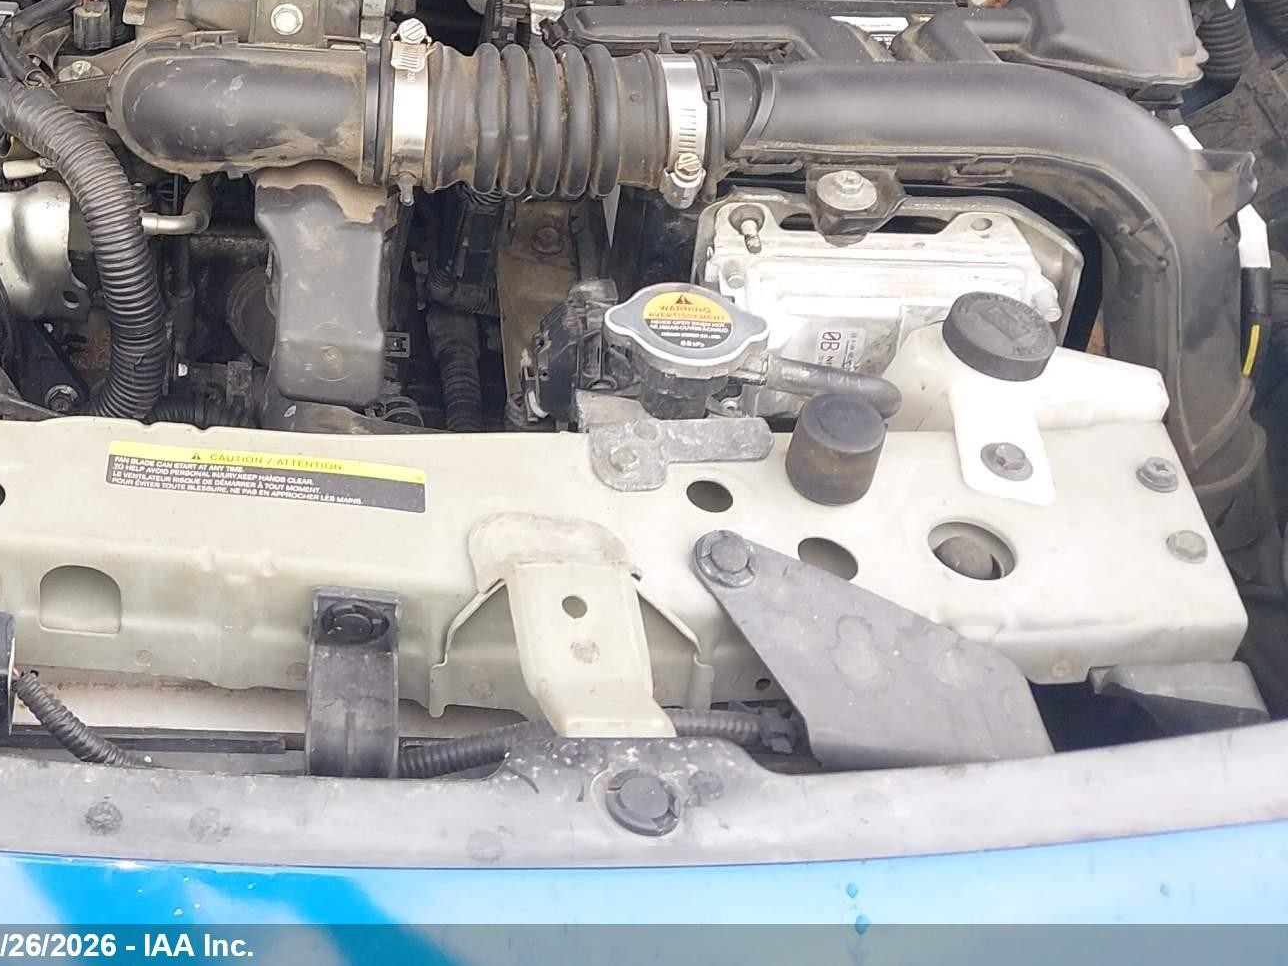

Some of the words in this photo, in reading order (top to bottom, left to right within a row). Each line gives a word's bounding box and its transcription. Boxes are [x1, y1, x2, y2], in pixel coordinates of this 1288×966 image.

[648, 311, 725, 321] AVERTISSEMENT
[658, 305, 711, 314] WARNING
[114, 456, 130, 464] FAN
[131, 458, 155, 467] BLADE
[156, 460, 172, 469] CAN
[173, 461, 197, 470] START
[208, 464, 223, 472] ANY
[210, 453, 263, 465] CAUTION
[276, 458, 342, 470] ATTENTION
[114, 462, 124, 470] TO
[125, 464, 145, 472] HELP
[145, 466, 169, 474] AVOID
[169, 468, 211, 478] PERSONAL
[258, 474, 286, 484] HANDS
[123, 471, 171, 482] VENTILATEUR
[172, 476, 202, 485] RISQUE
[213, 477, 257, 488] DÉMARRER
[264, 483, 284, 491] TOUT
[112, 477, 133, 485] POUR
[134, 478, 161, 489] ÉVITER
[162, 482, 186, 490] TOUTE
[241, 488, 258, 496] PAS
[270, 490, 320, 501] APPROCHER
[320, 494, 335, 503] LES
